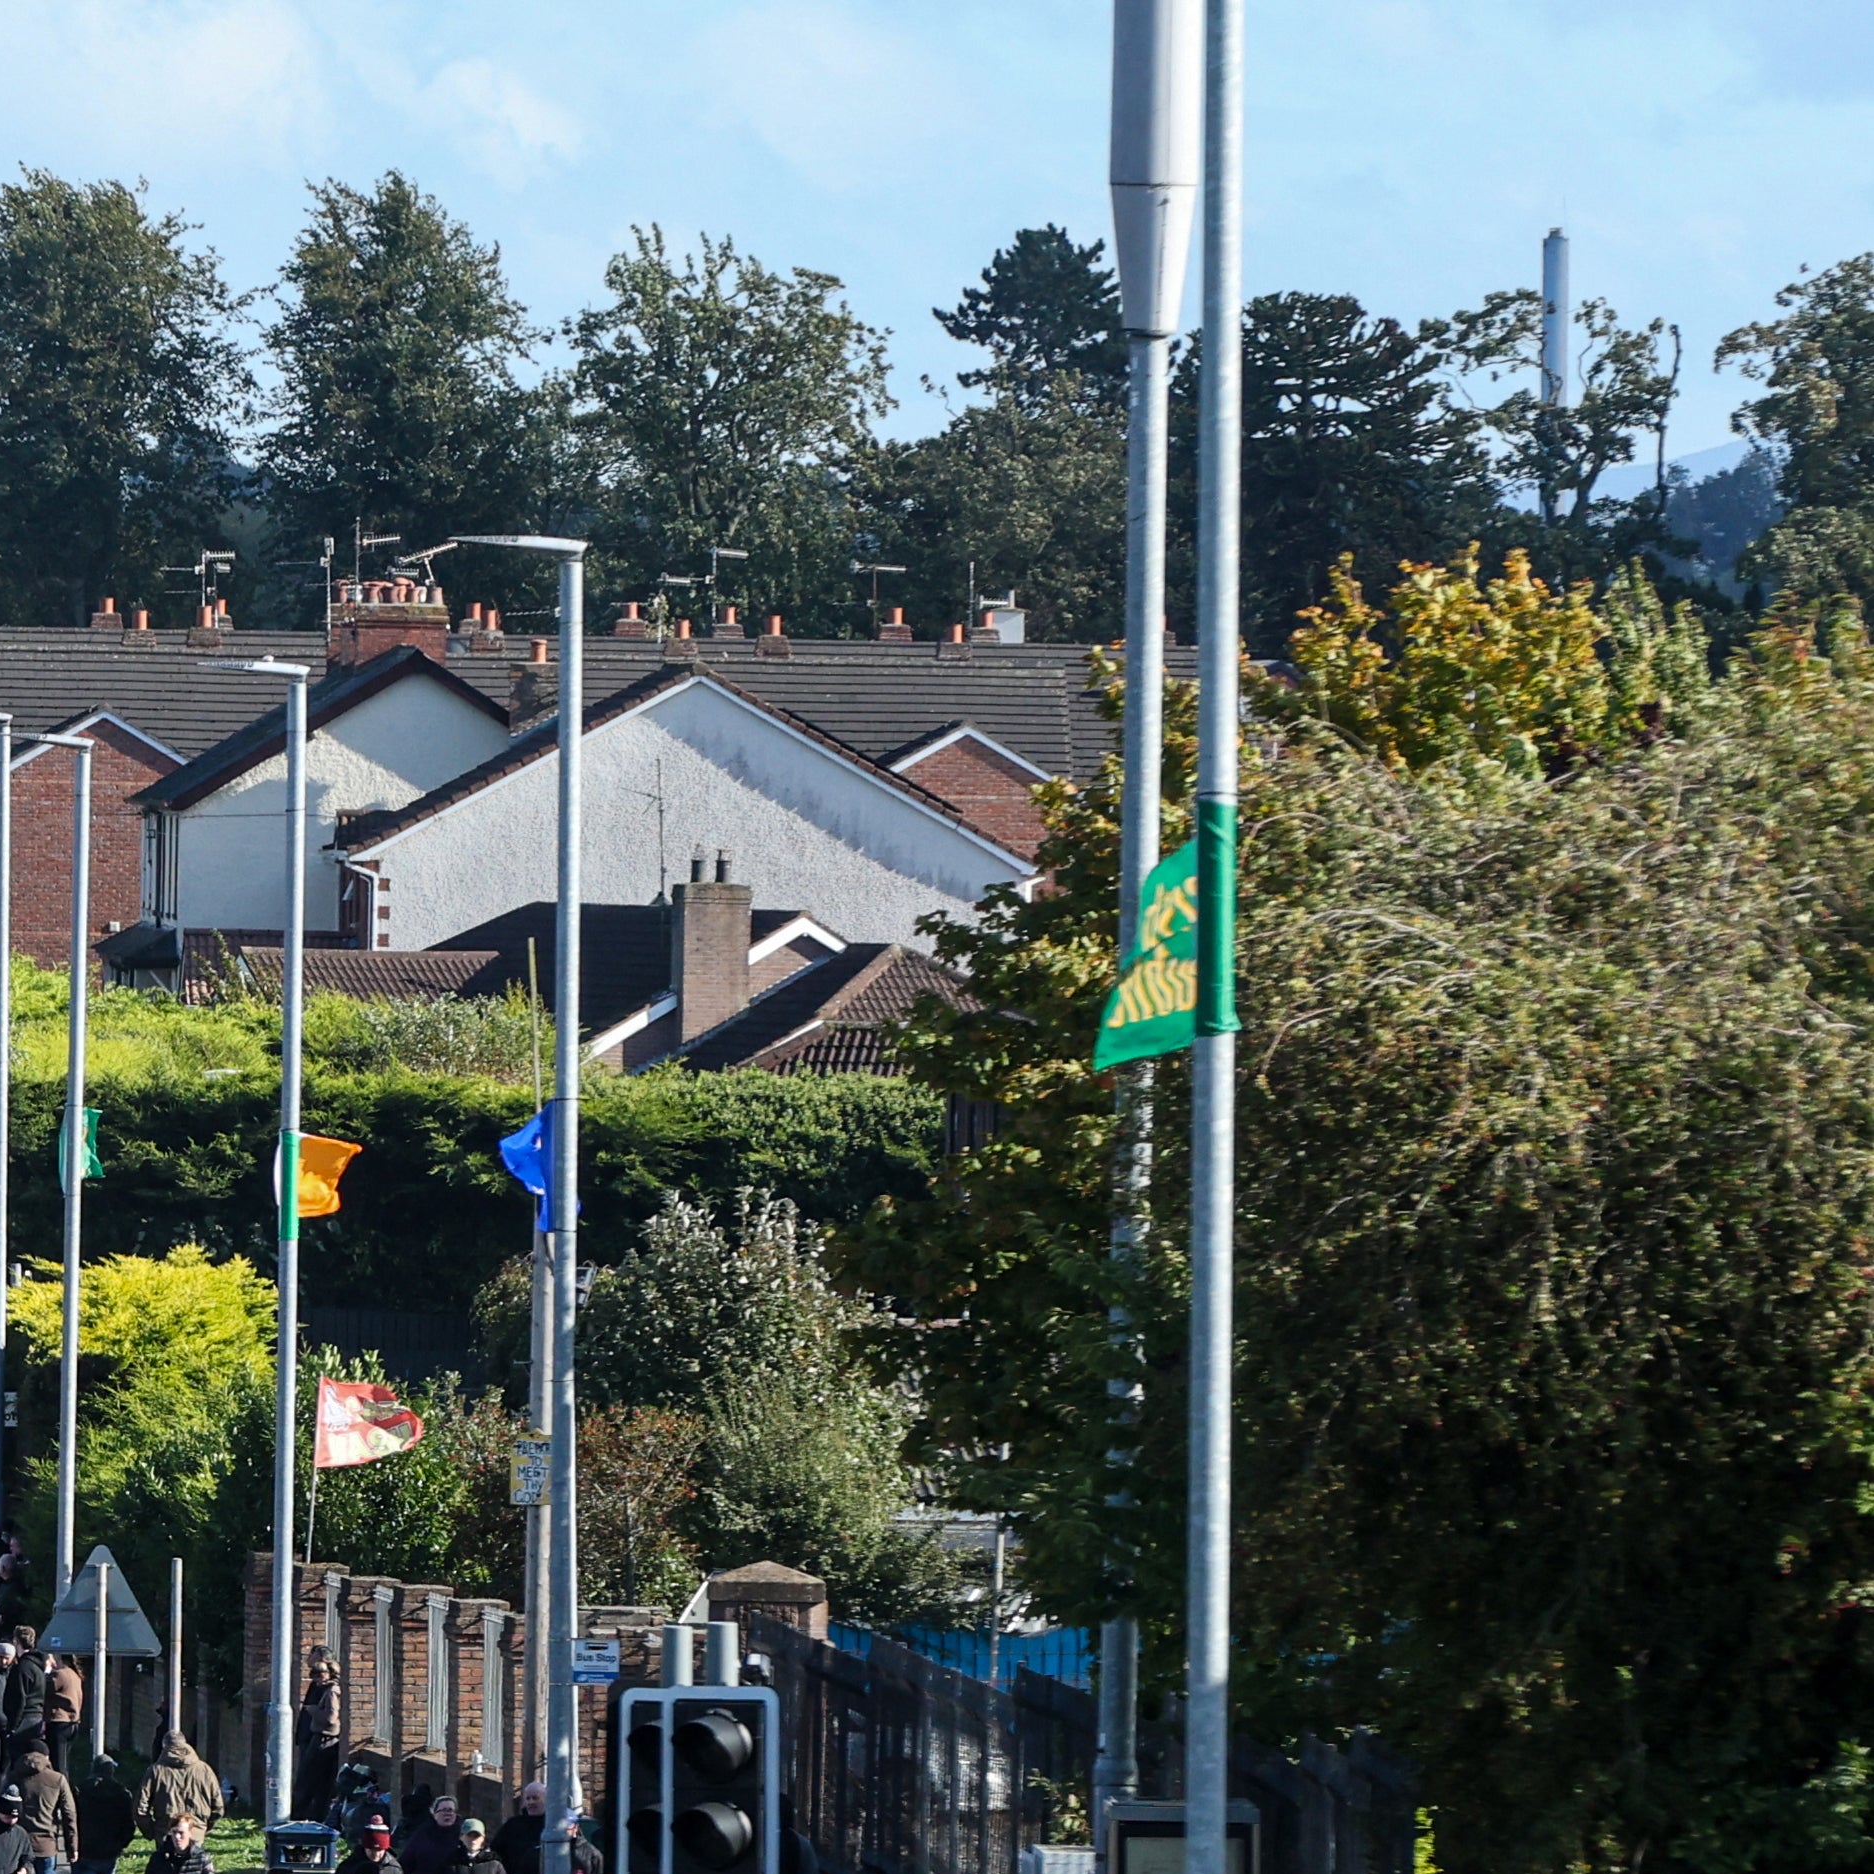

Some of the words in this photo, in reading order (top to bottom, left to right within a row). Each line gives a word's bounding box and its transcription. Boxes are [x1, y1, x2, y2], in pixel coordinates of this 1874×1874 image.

[529, 1455, 543, 1467] TO
[576, 1653, 594, 1662] Bus
[596, 1653, 617, 1664] Stop
